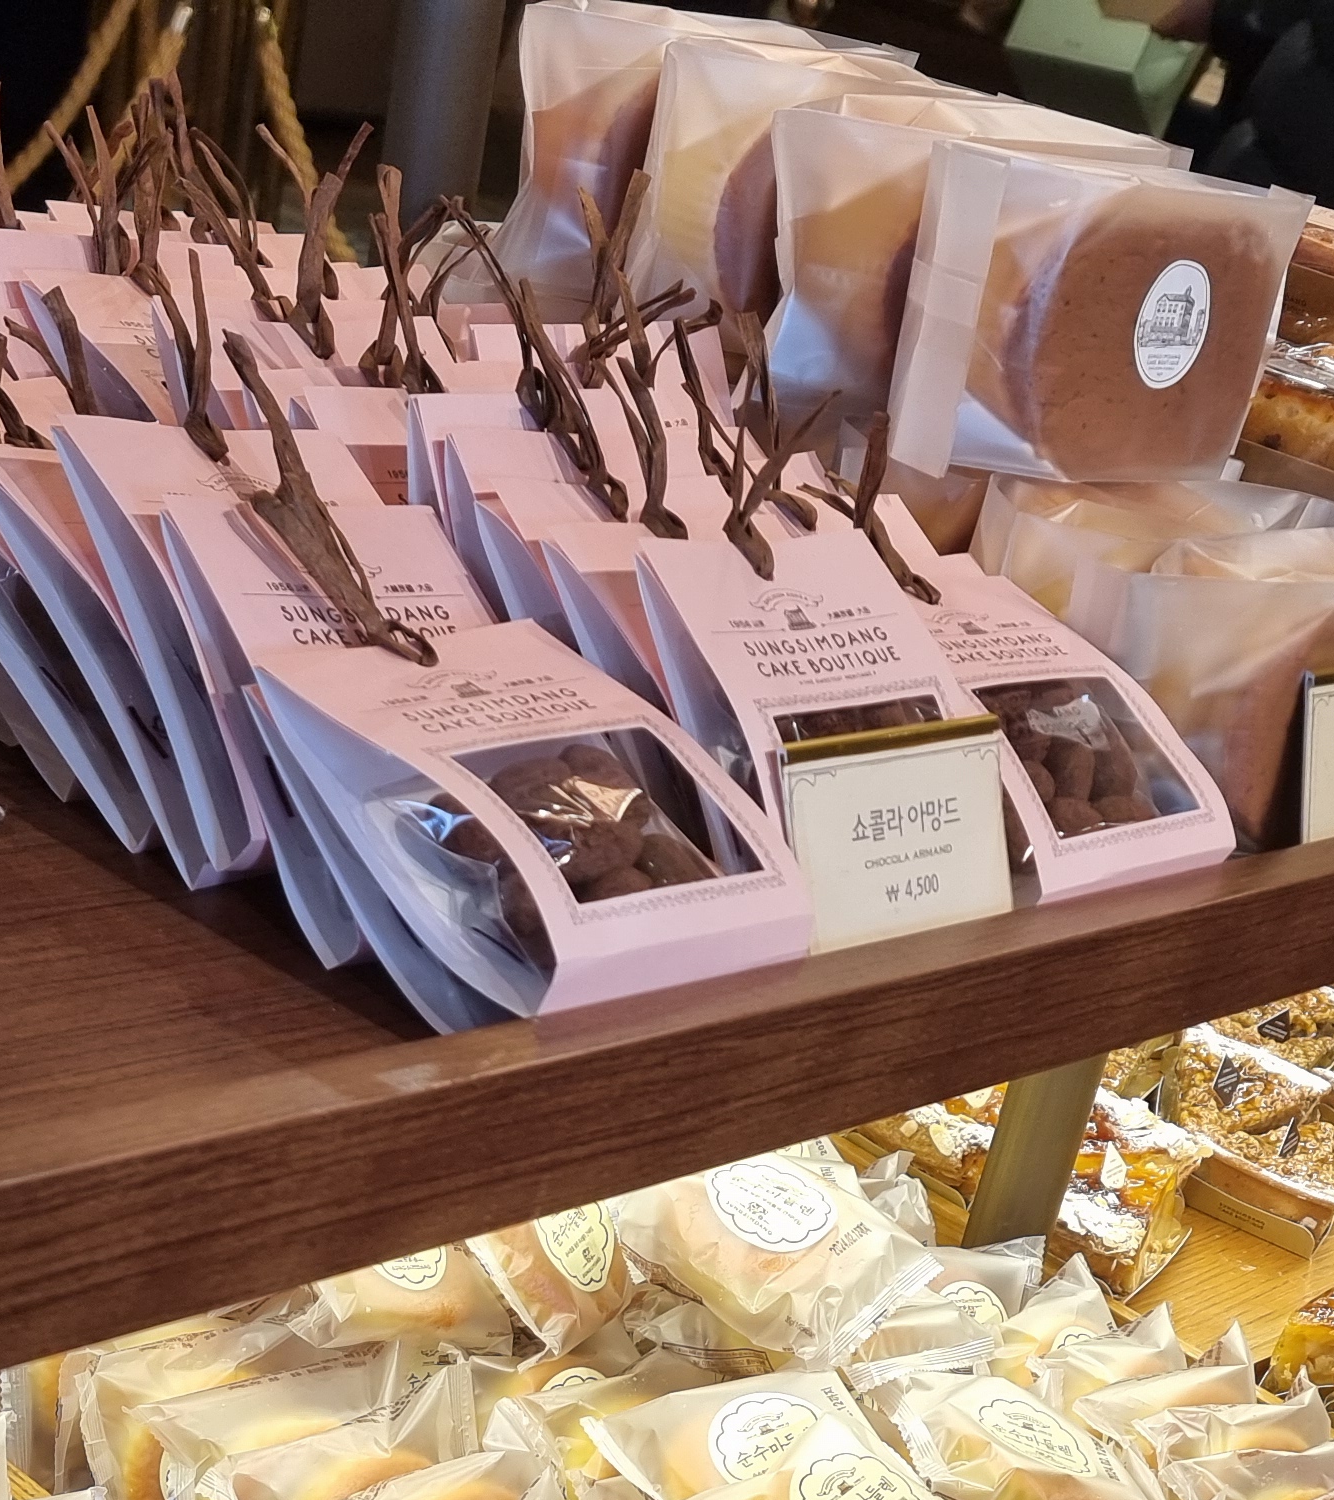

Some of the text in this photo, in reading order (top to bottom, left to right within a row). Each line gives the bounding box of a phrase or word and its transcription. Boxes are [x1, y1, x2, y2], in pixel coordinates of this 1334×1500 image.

[281, 605, 450, 624] SUNGSDANG
[293, 628, 346, 646] CAKE
[743, 626, 888, 657] SUNGSIMDANG
[937, 633, 1052, 651] UNGSIMDANG
[757, 646, 901, 678] CAKE BOUTIQUE
[946, 645, 1069, 664] CAKE BOUTIQUE
[402, 687, 578, 722] SUNGSIMDANG
[422, 698, 597, 733] CAKE BOUTIQUE
[852, 797, 961, 842] 쇼콜라 아망드
[864, 844, 953, 870] CHOCOLA ARMAND
[886, 873, 940, 903] ₩ 4,500
